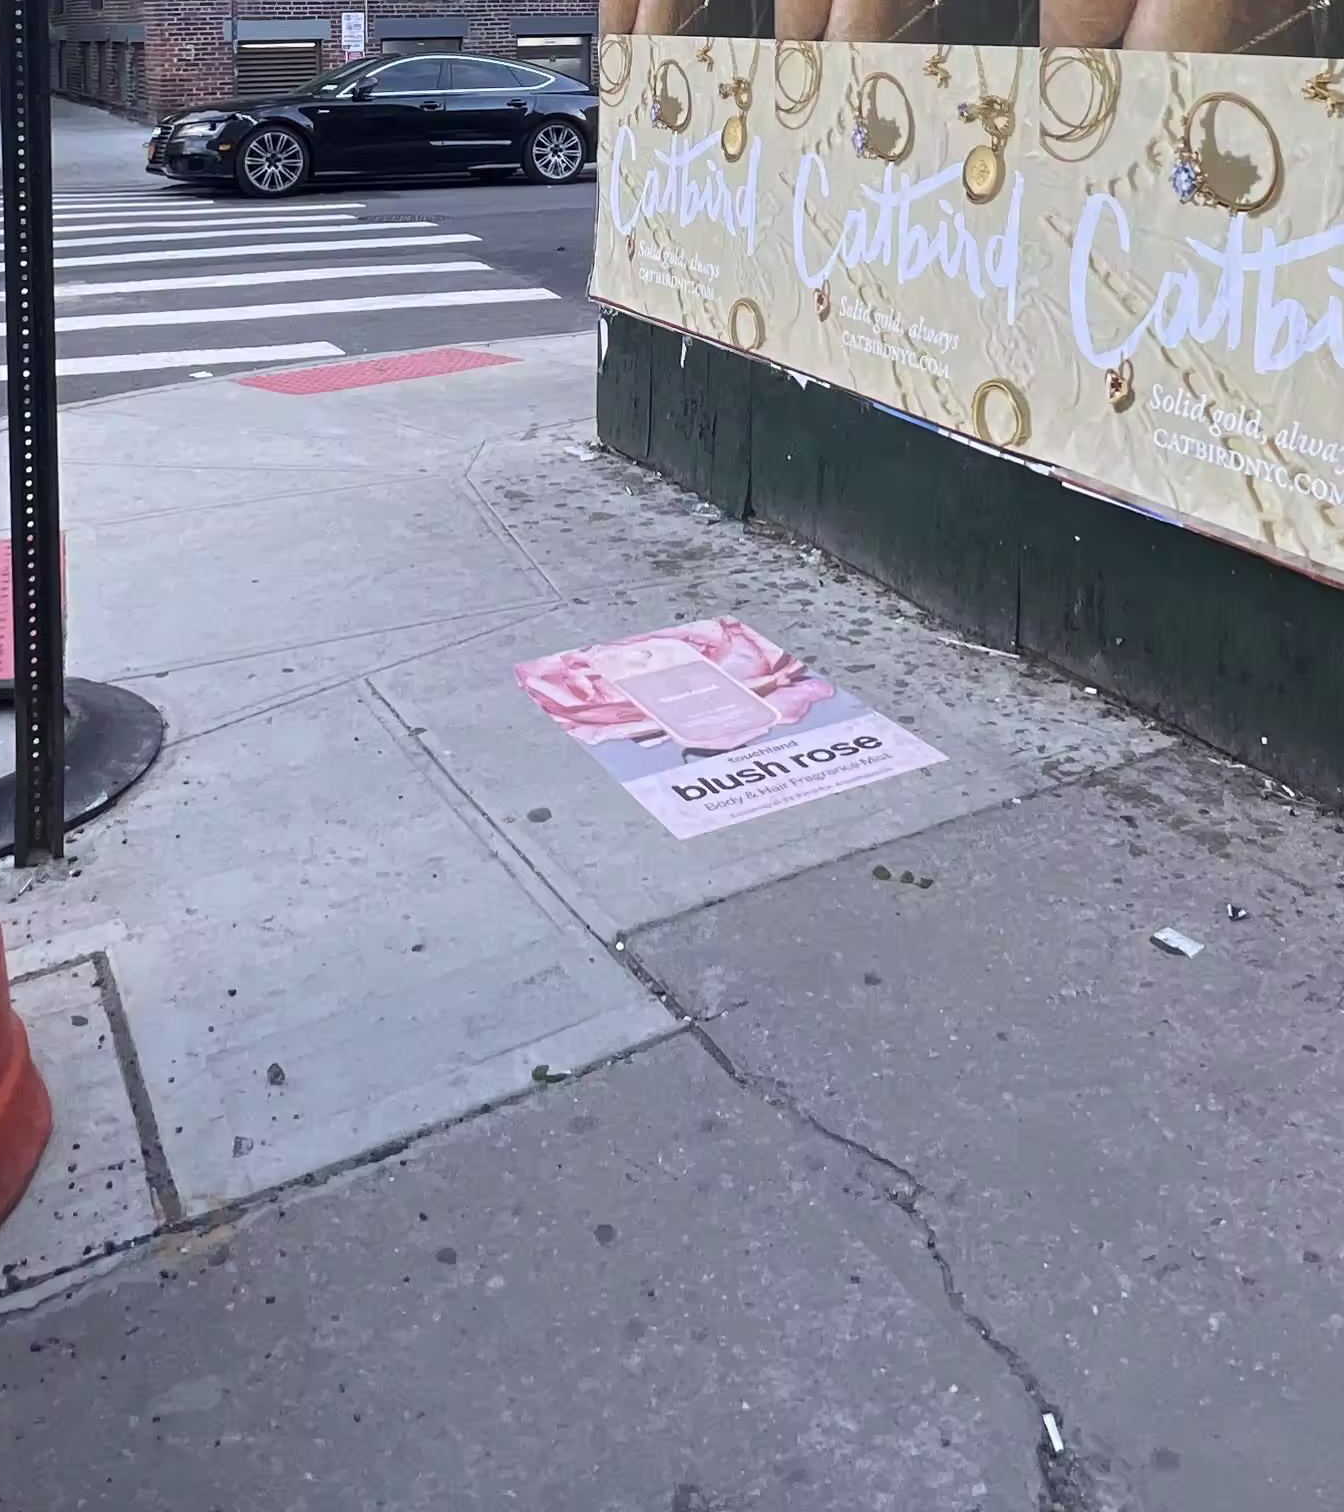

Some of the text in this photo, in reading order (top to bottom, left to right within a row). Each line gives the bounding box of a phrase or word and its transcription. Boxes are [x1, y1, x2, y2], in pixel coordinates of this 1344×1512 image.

[610, 125, 762, 257] Catbird
[792, 152, 1025, 326] Catbird
[839, 295, 960, 354] Solid gold, always
[842, 330, 950, 379] CATBIRDNYC.COM
[1150, 383, 1207, 423] Solid
[1210, 409, 1269, 446] gold,
[671, 760, 791, 802] blush
[789, 735, 883, 768] rose
[705, 796, 744, 812] Body
[757, 782, 790, 796] Hair
[789, 762, 861, 787] Fragrance
[860, 752, 894, 767] Mist
